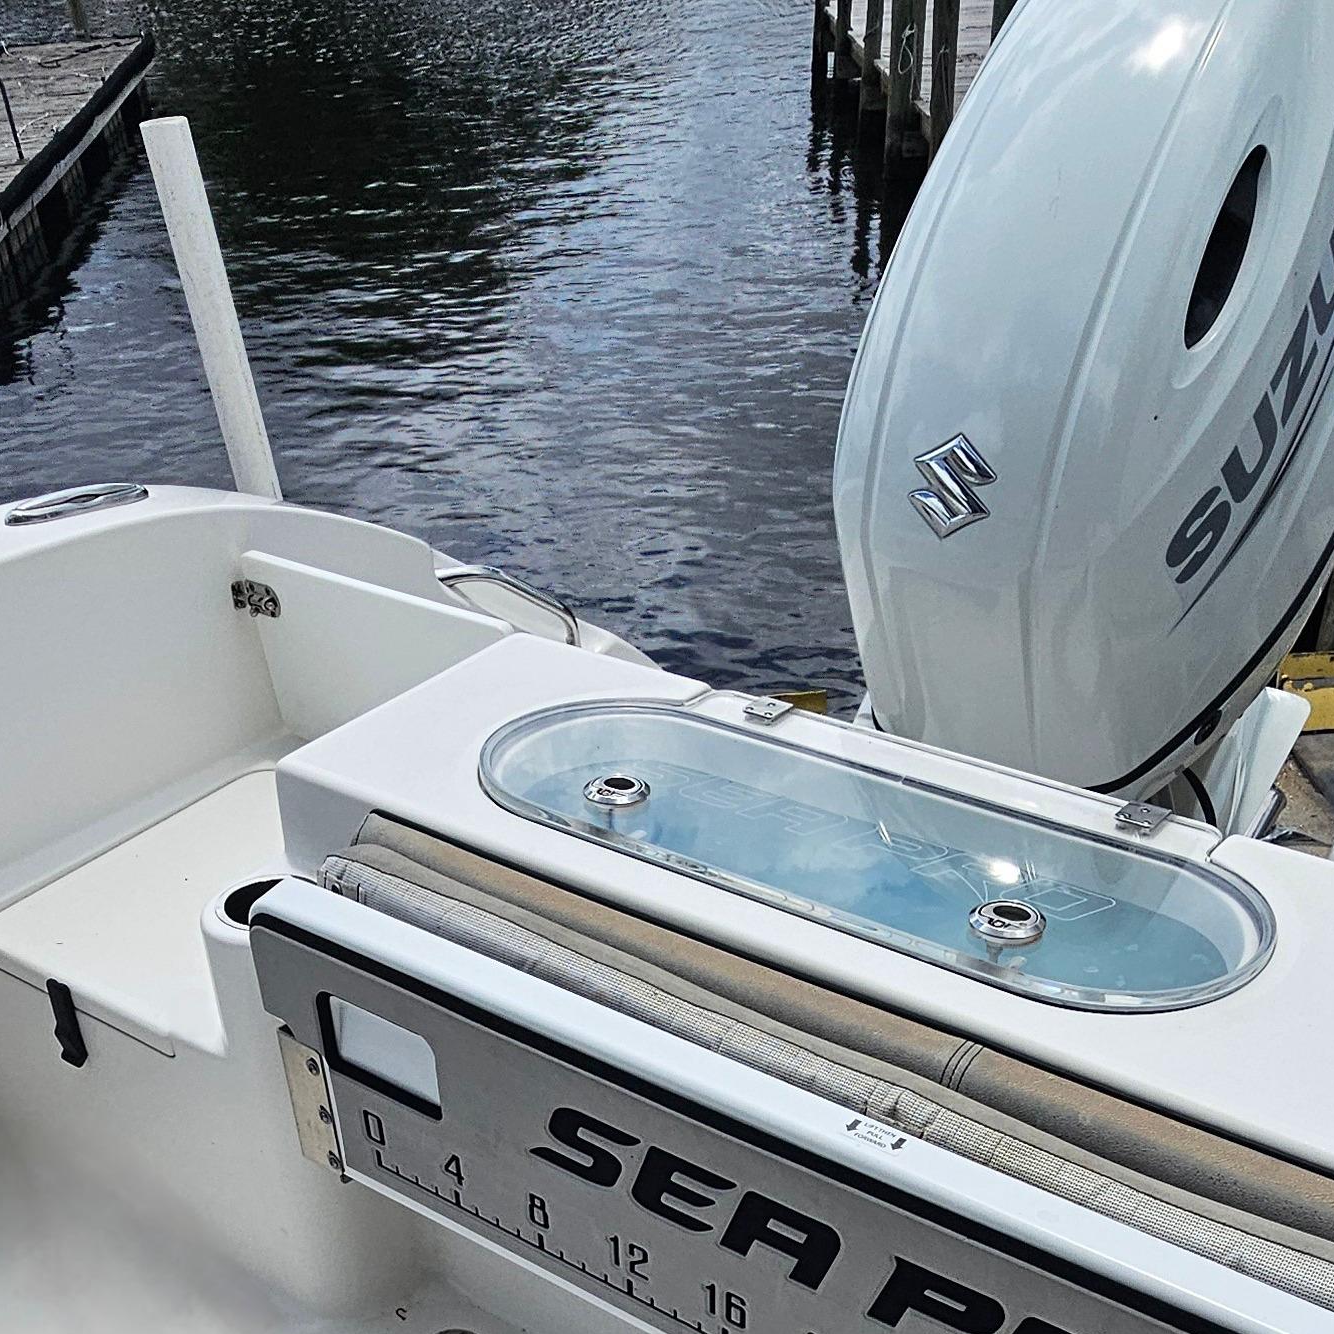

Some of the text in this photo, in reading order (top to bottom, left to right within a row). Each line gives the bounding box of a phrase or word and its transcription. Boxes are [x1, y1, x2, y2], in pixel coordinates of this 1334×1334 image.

[362, 1109, 386, 1147] 0
[444, 1154, 465, 1187] 4
[528, 1192, 550, 1230] 8
[609, 1235, 649, 1282] 12
[705, 1283, 747, 1330] 16
[529, 1106, 841, 1291] SEA
